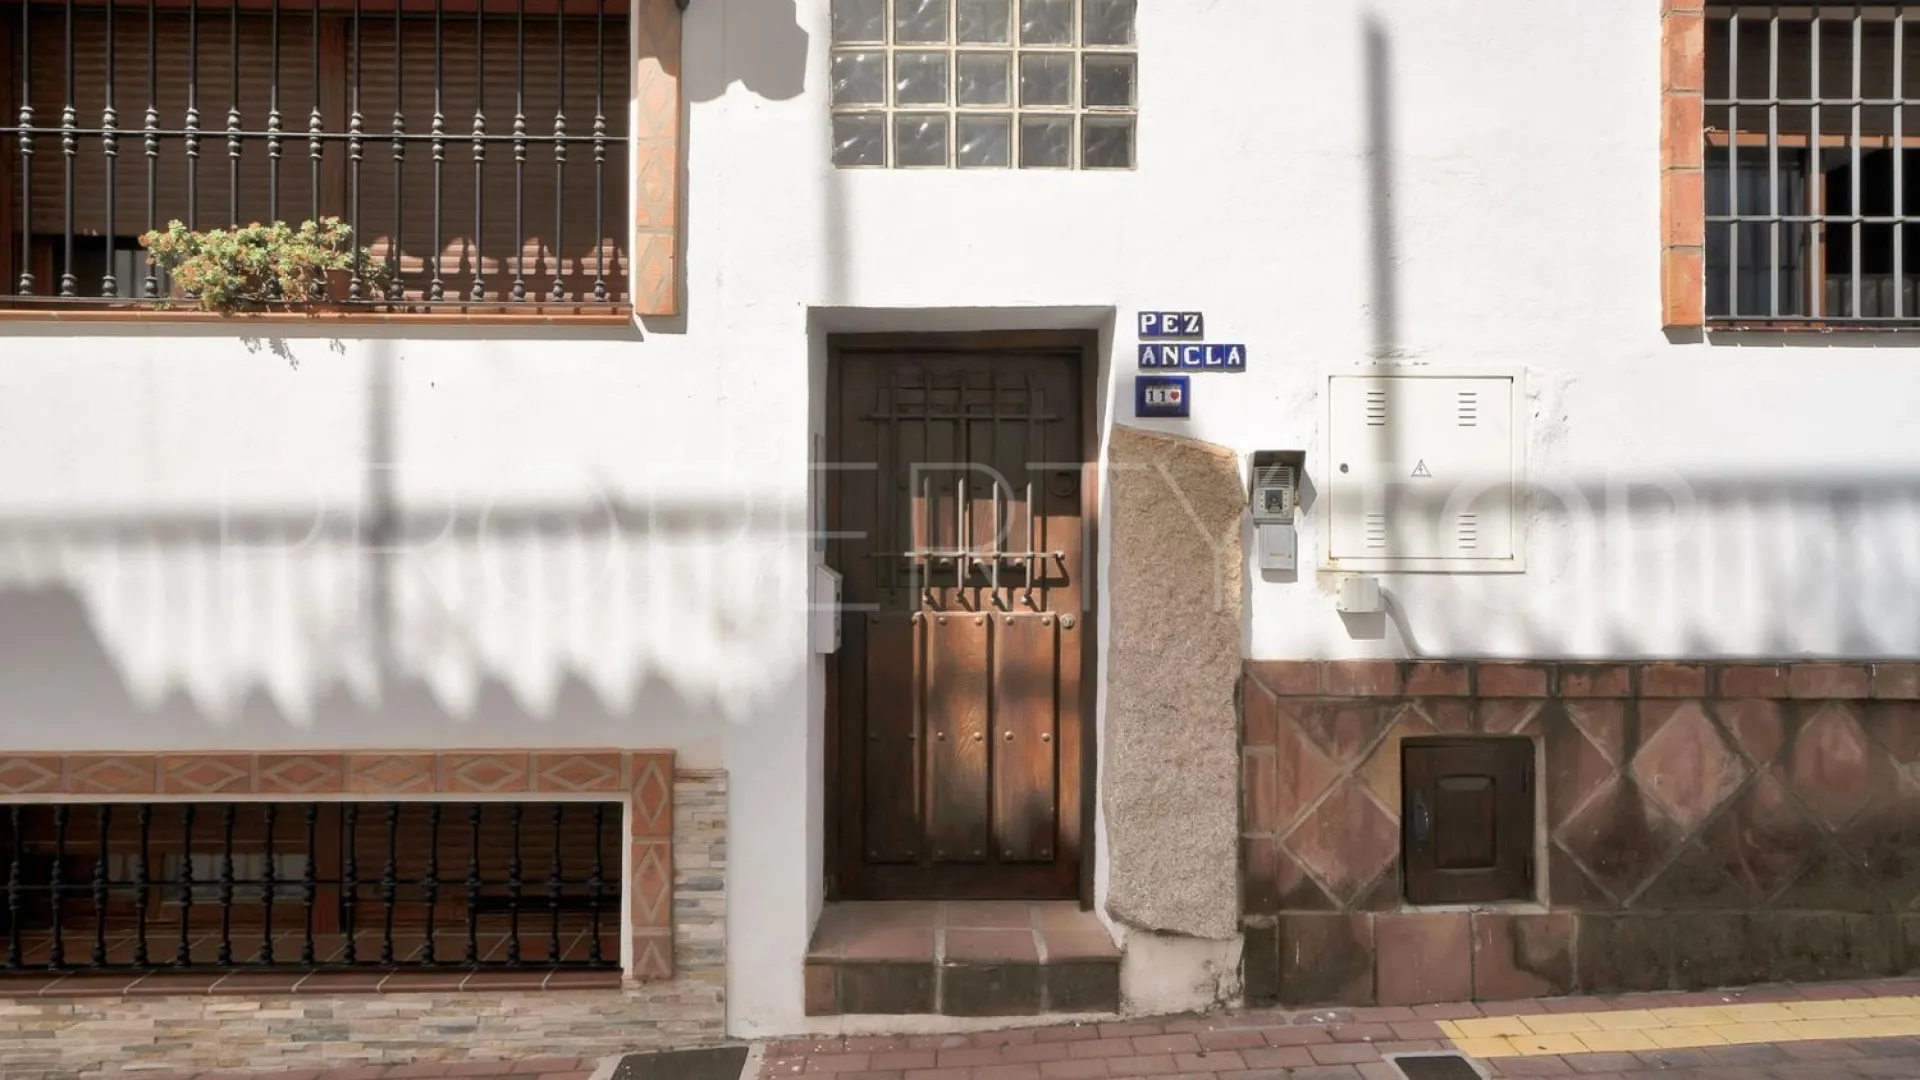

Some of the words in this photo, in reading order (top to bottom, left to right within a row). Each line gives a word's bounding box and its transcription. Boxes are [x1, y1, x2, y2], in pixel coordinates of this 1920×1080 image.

[1141, 313, 1199, 334] PEZ
[1141, 345, 1241, 365] ANCLA
[1147, 389, 1167, 403] 11
